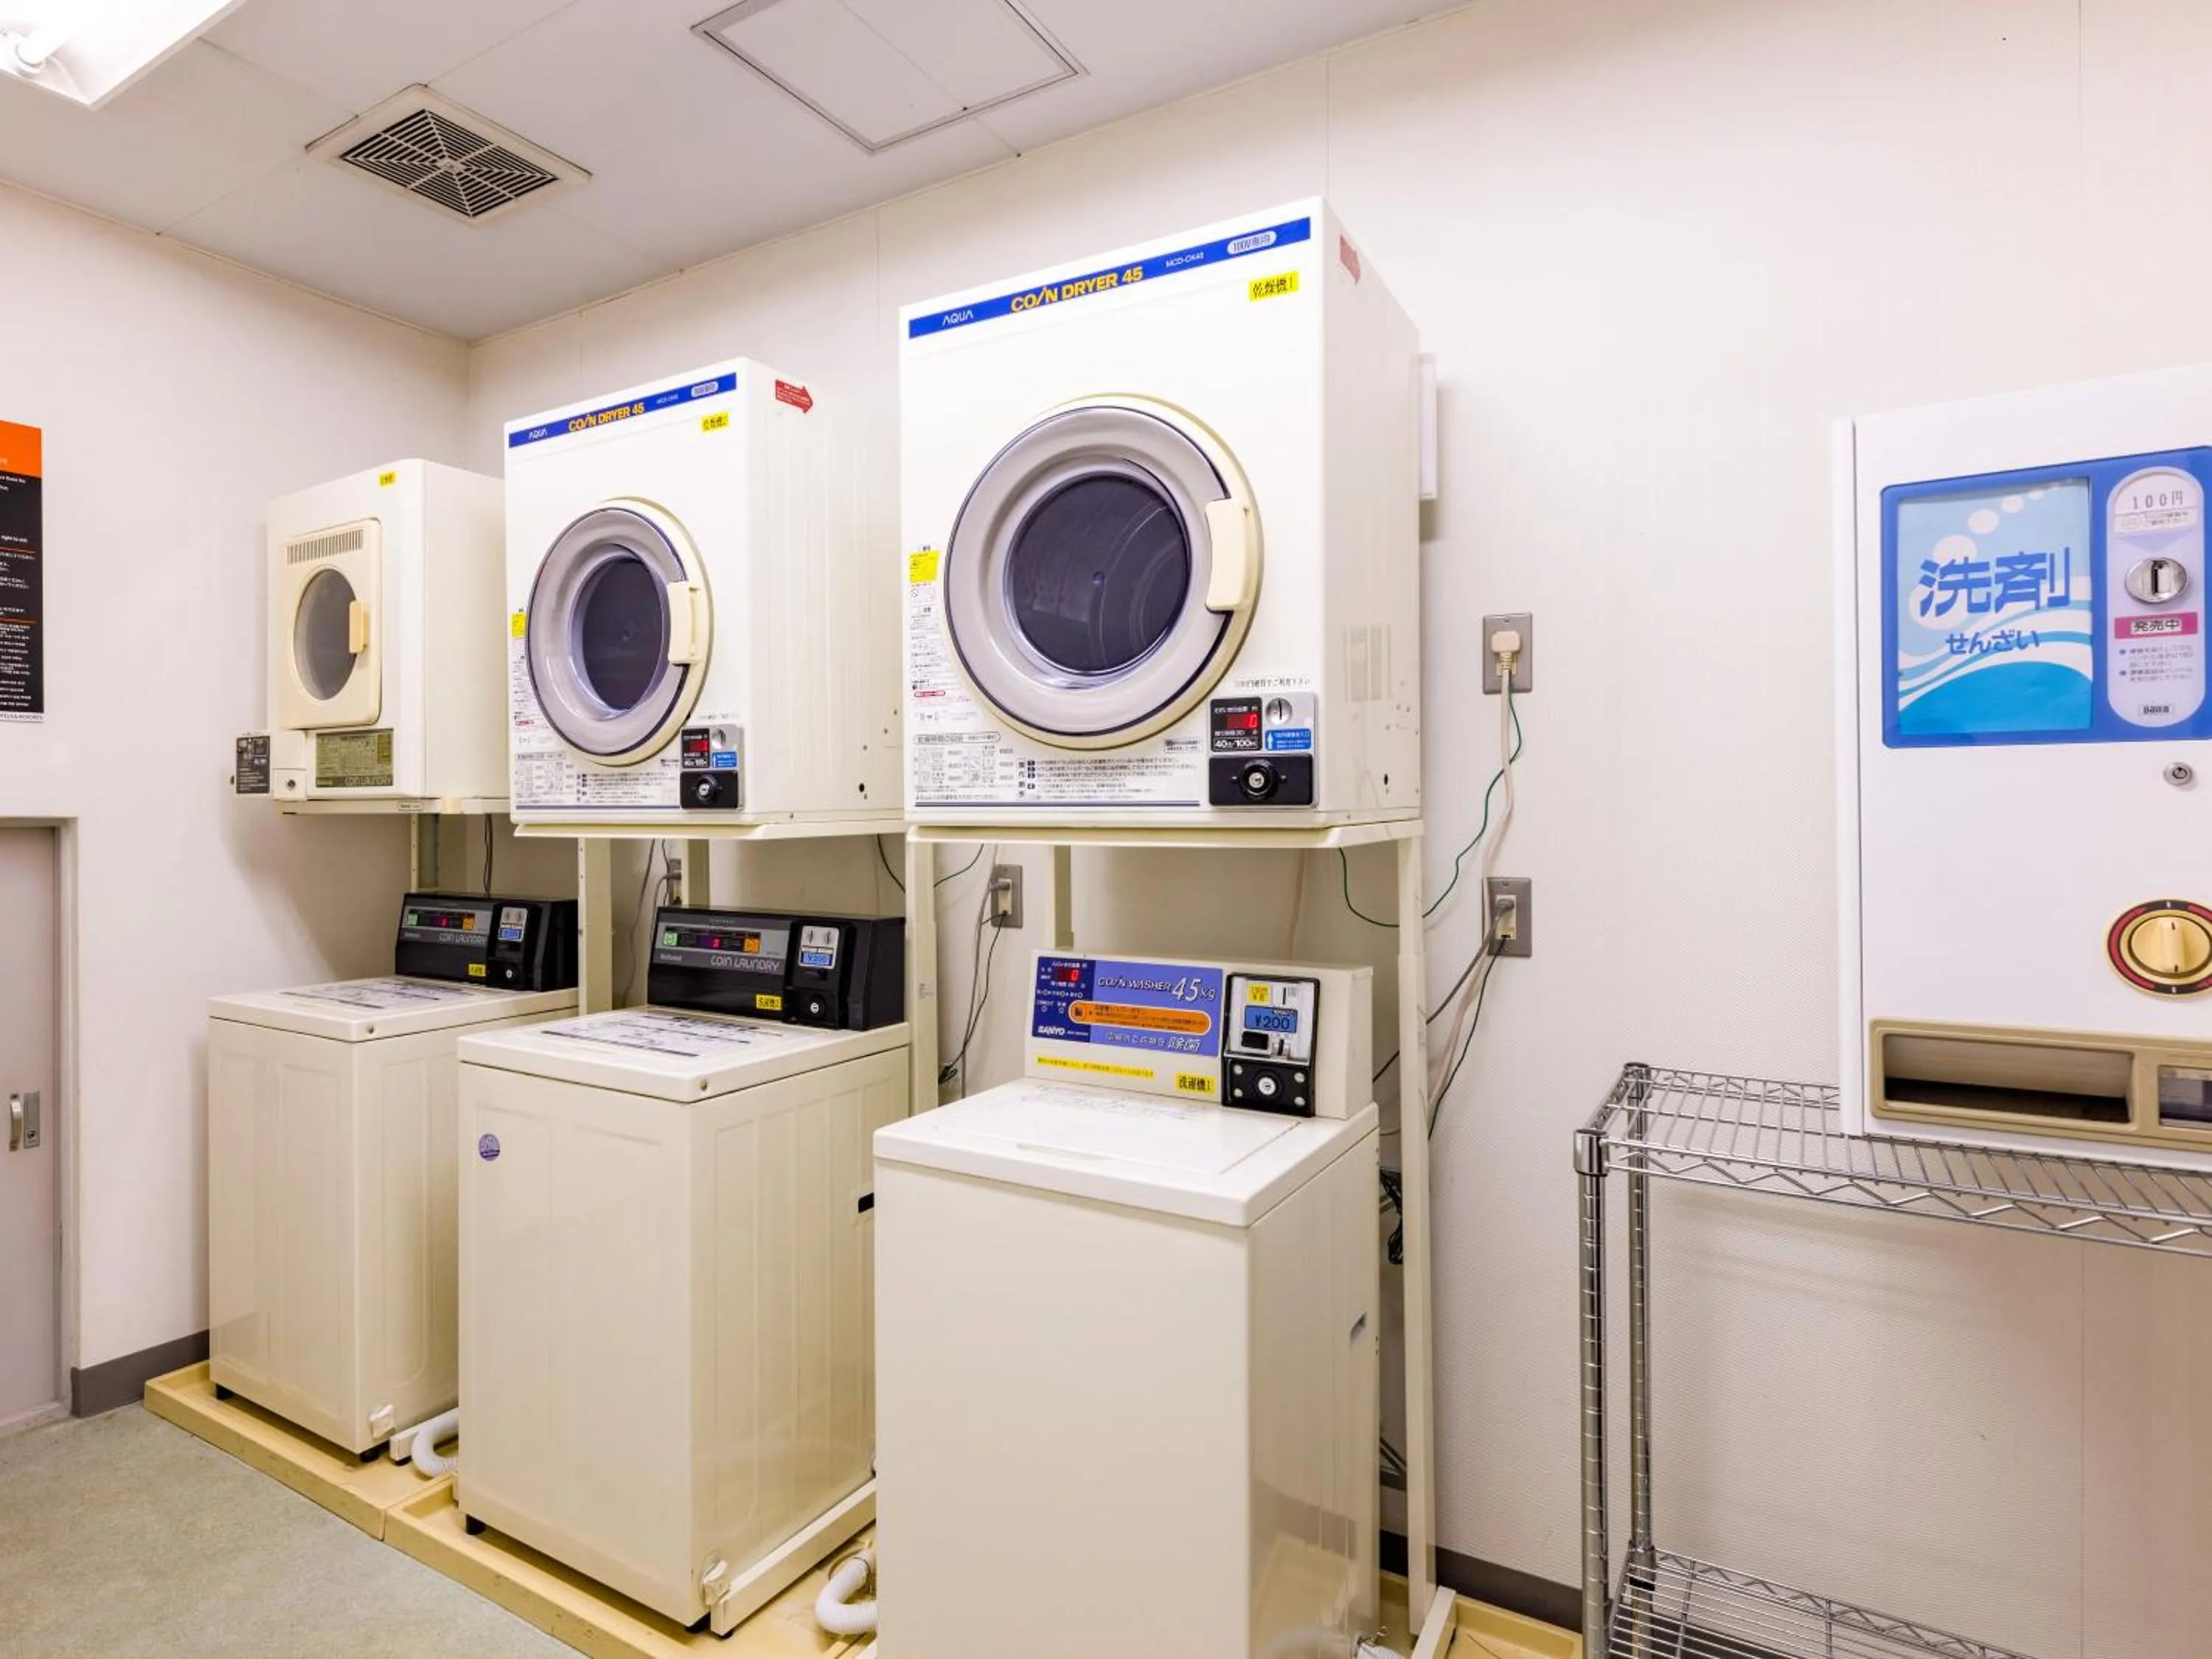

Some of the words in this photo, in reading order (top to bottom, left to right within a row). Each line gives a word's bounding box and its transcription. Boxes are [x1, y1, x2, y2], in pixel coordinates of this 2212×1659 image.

[942, 309, 974, 327] AQUA
[1061, 273, 1119, 300] DRYER
[1121, 266, 1144, 285] 45
[598, 406, 630, 424] DRYER
[1919, 546, 2070, 618] 洗剤
[2133, 619, 2180, 632] 発売中
[1945, 628, 2040, 655] せんざい
[710, 954, 733, 967] COIN
[734, 957, 780, 973] LAUNDRY
[1128, 980, 1172, 992] WASHER
[1037, 1026, 1065, 1036] SANYO
[1255, 1014, 1290, 1030] ¥200
